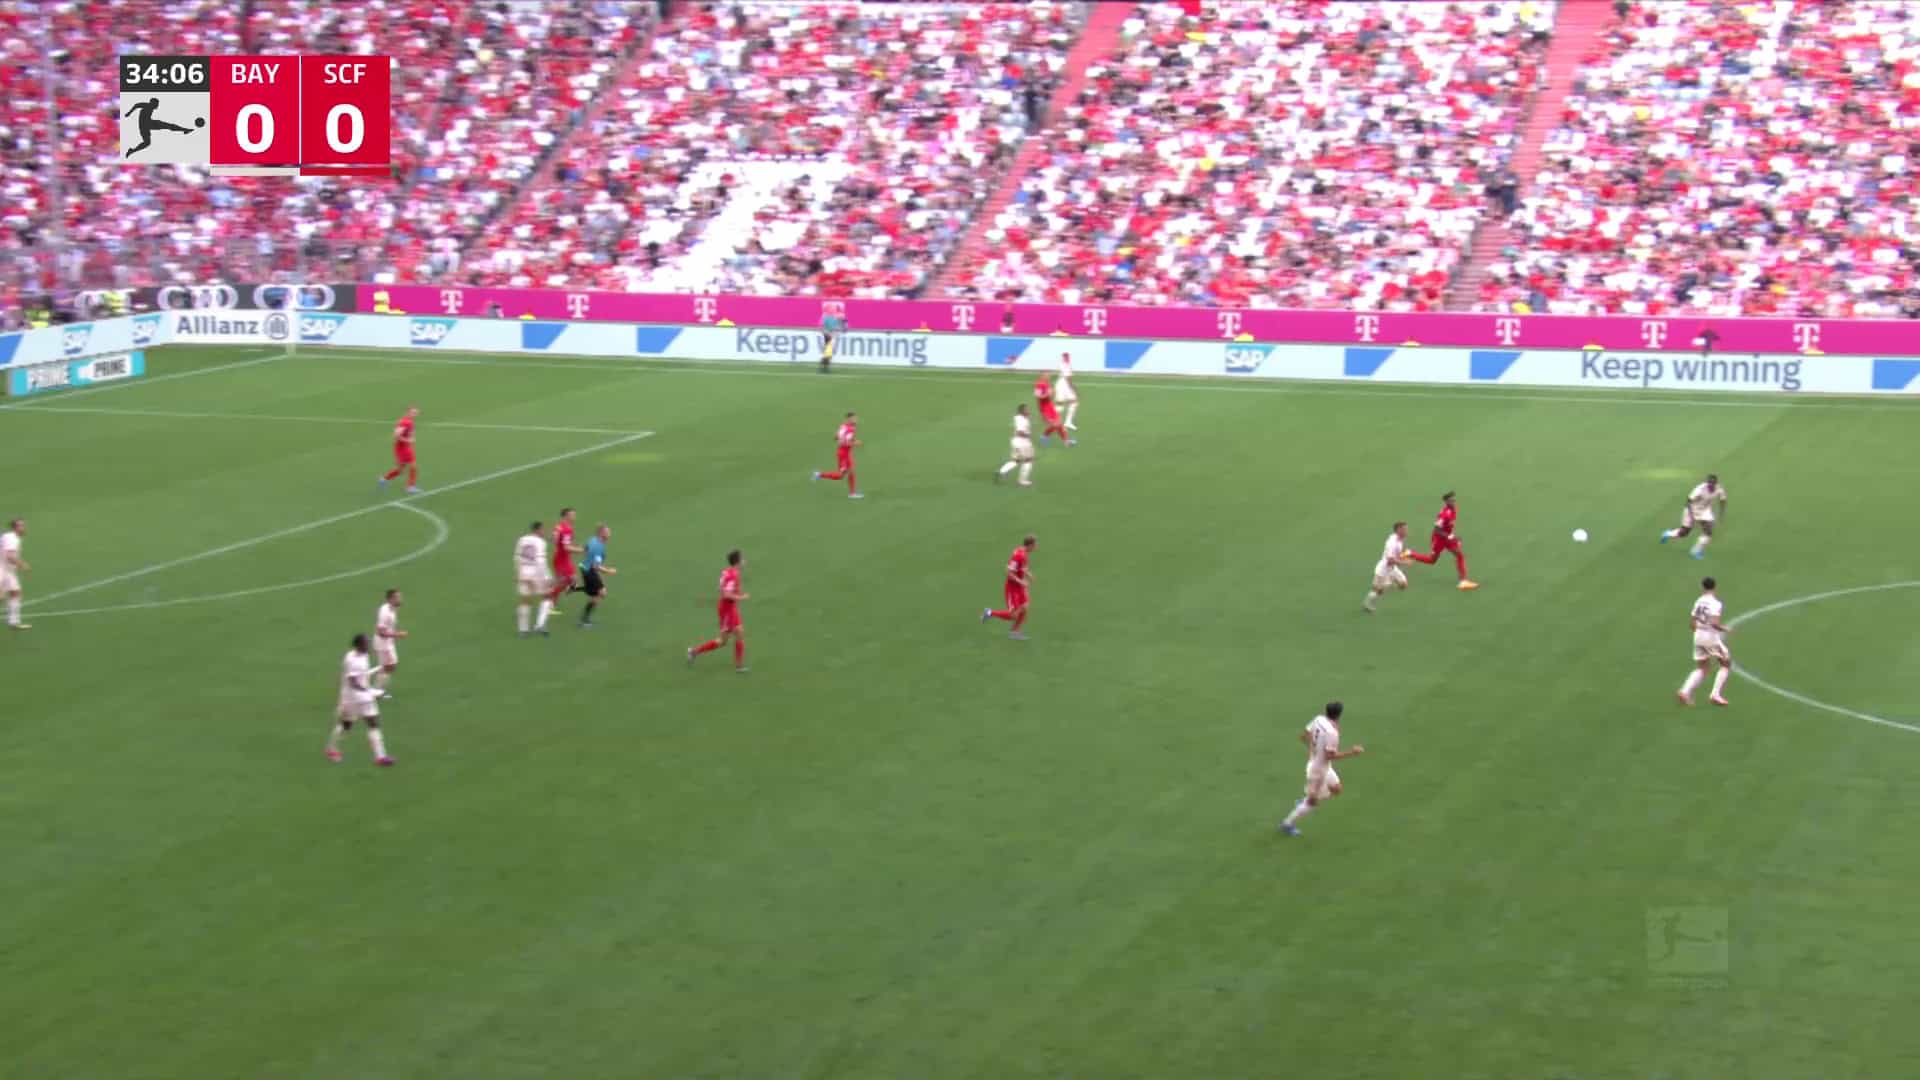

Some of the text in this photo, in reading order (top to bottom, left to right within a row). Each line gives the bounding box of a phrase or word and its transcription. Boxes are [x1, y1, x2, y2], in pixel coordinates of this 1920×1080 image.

[440, 289, 463, 314] T
[567, 293, 590, 318] T
[694, 297, 717, 322] T
[176, 315, 259, 335] Allianz
[301, 316, 338, 337] SAP
[951, 304, 975, 330] T
[1083, 308, 1107, 334] T
[1217, 312, 1241, 338] T
[1355, 315, 1379, 341] T
[411, 321, 449, 343] SAP
[735, 328, 809, 360] Keep
[1496, 318, 1521, 345] T
[1641, 320, 1667, 348] T
[1793, 323, 1820, 351] T
[1225, 347, 1265, 370] SAP
[1581, 350, 1802, 391] Keep winning
